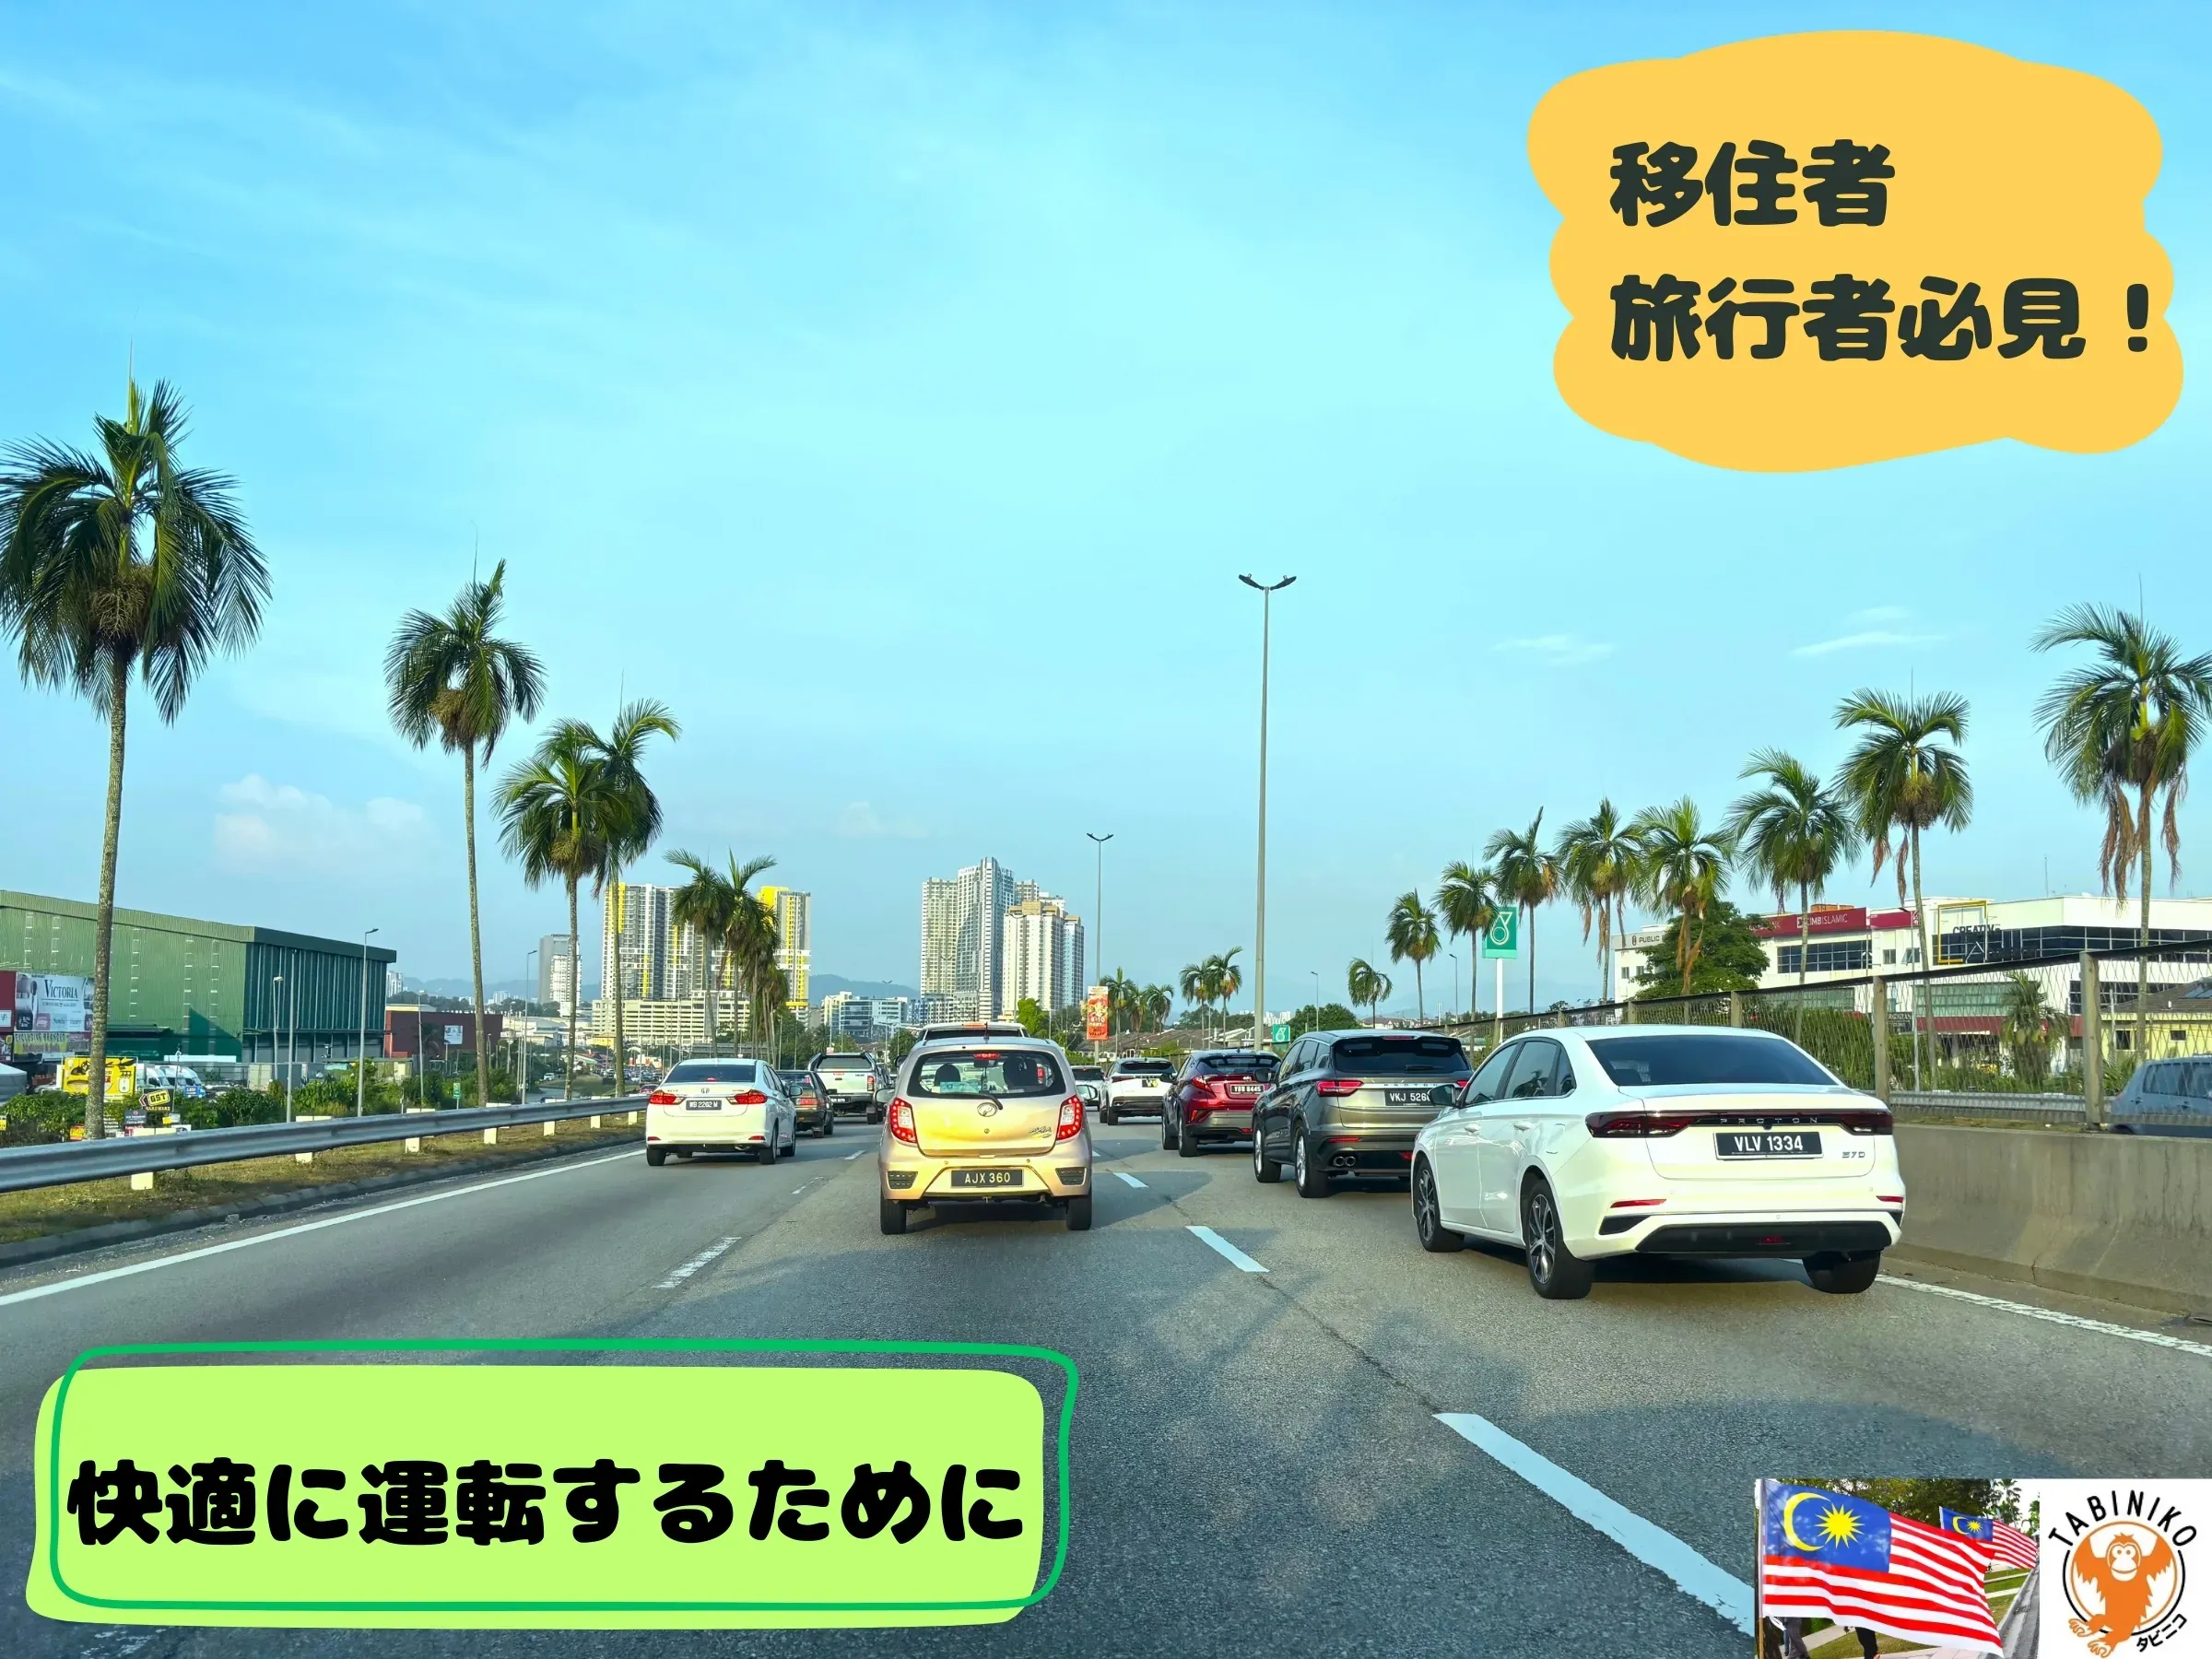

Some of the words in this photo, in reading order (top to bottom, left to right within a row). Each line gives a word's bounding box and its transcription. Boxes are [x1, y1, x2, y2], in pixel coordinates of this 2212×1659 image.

[1639, 935, 1660, 944] PUBLIC
[150, 1091, 167, 1103] GST
[1389, 1092, 1406, 1102] VKJ
[1734, 1135, 1761, 1152] VLV
[1767, 1135, 1804, 1151] 1334
[964, 1172, 986, 1184] AJX
[989, 1171, 1011, 1183] 360
